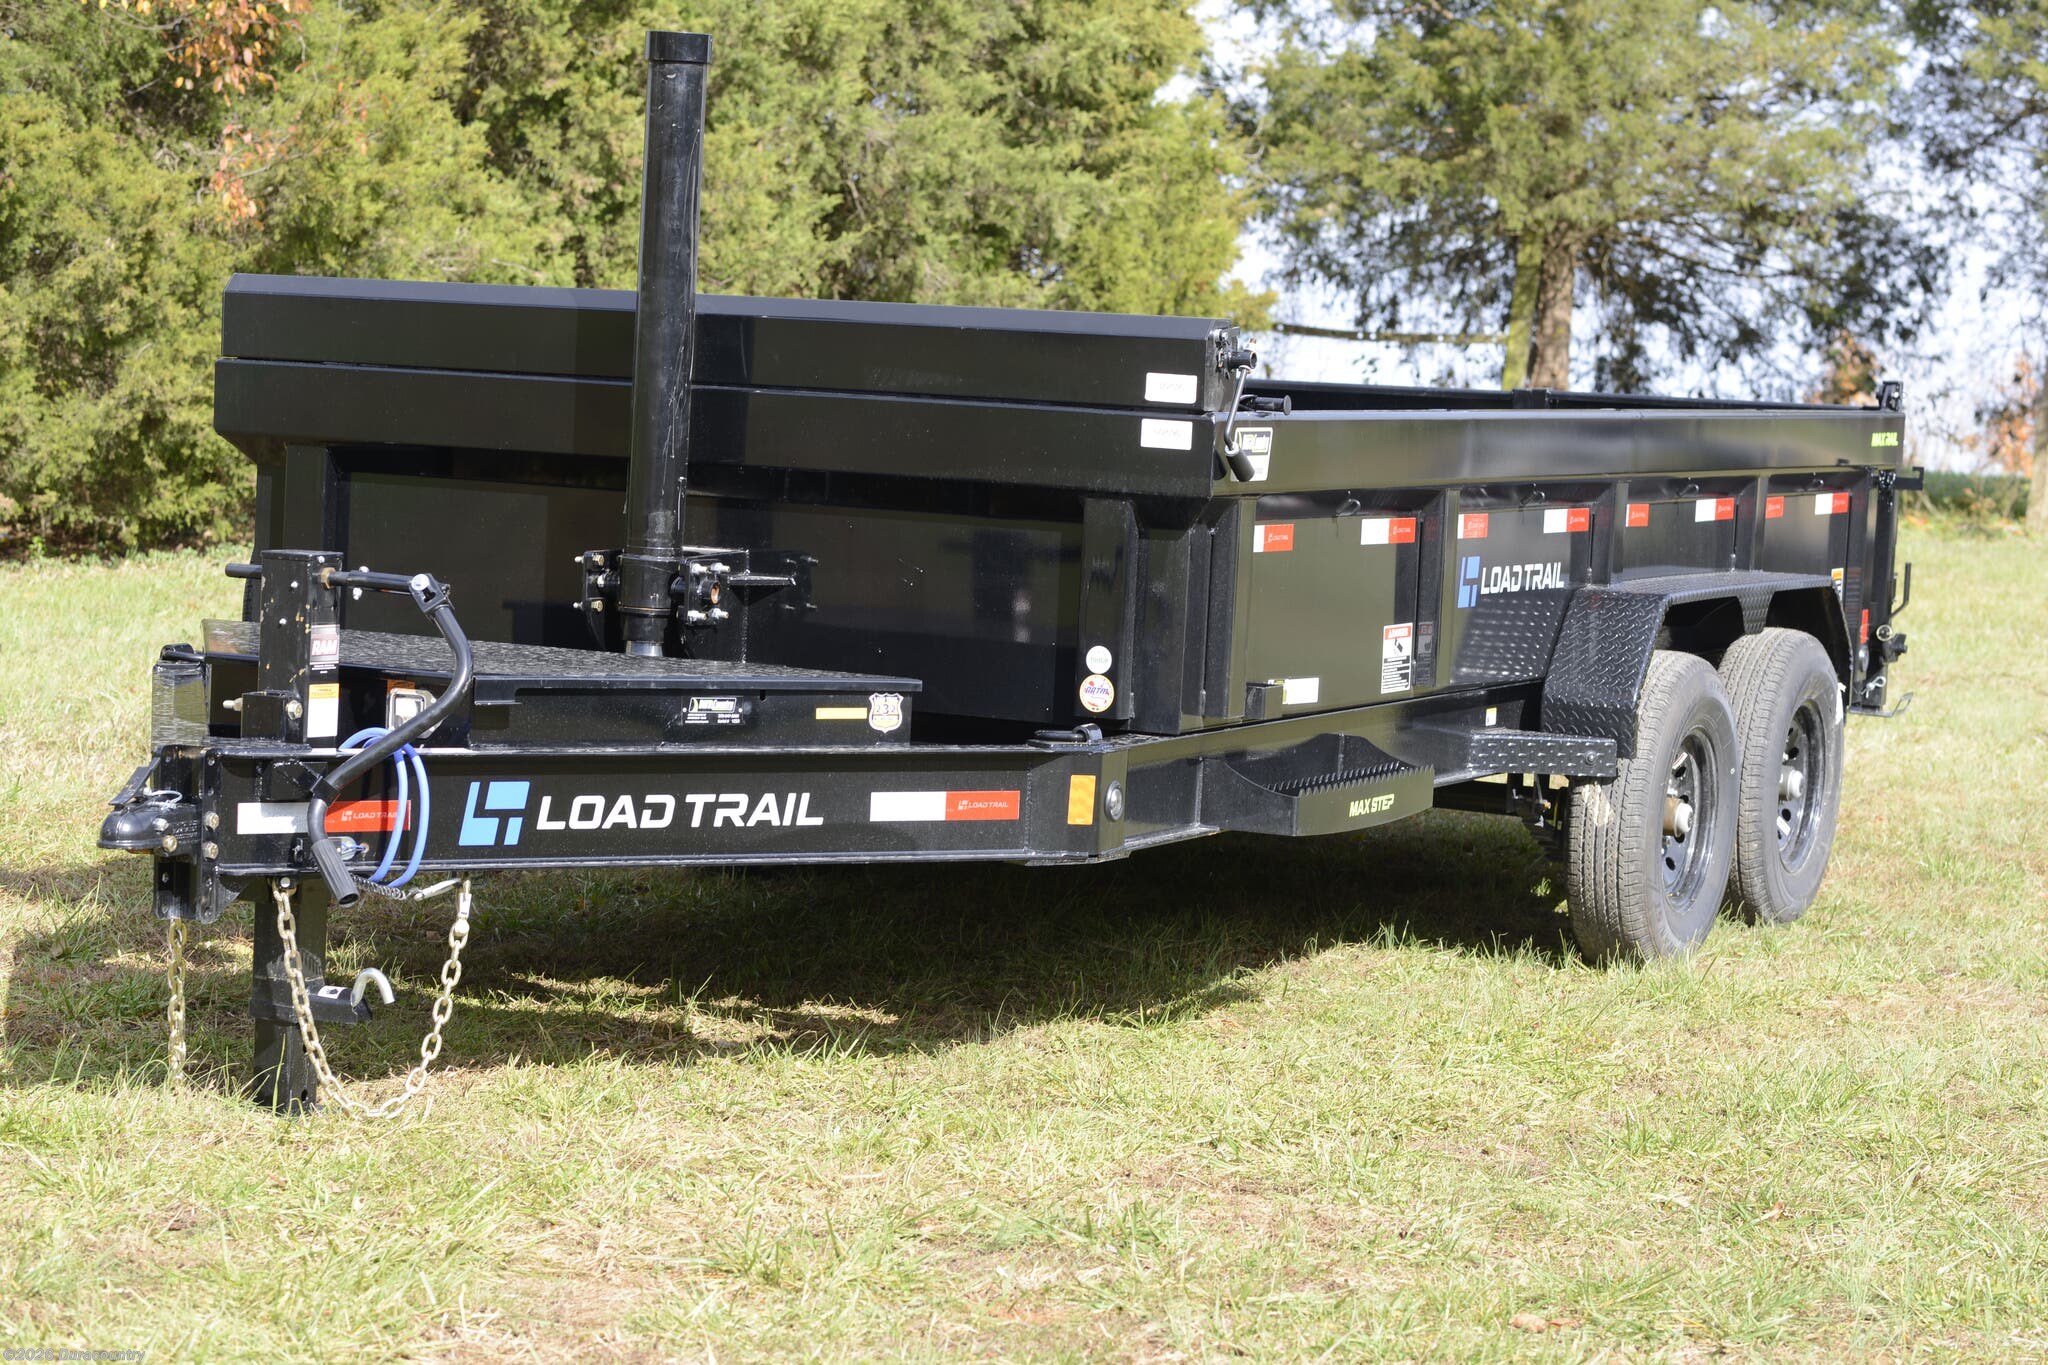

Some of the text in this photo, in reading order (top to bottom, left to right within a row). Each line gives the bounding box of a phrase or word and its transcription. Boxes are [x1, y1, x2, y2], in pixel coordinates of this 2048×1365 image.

[1480, 561, 1565, 595] LOAD TRAIL
[311, 639, 337, 656] RAM
[536, 792, 824, 831] LOAD TRAIL
[1348, 793, 1395, 818] MAX STEP
